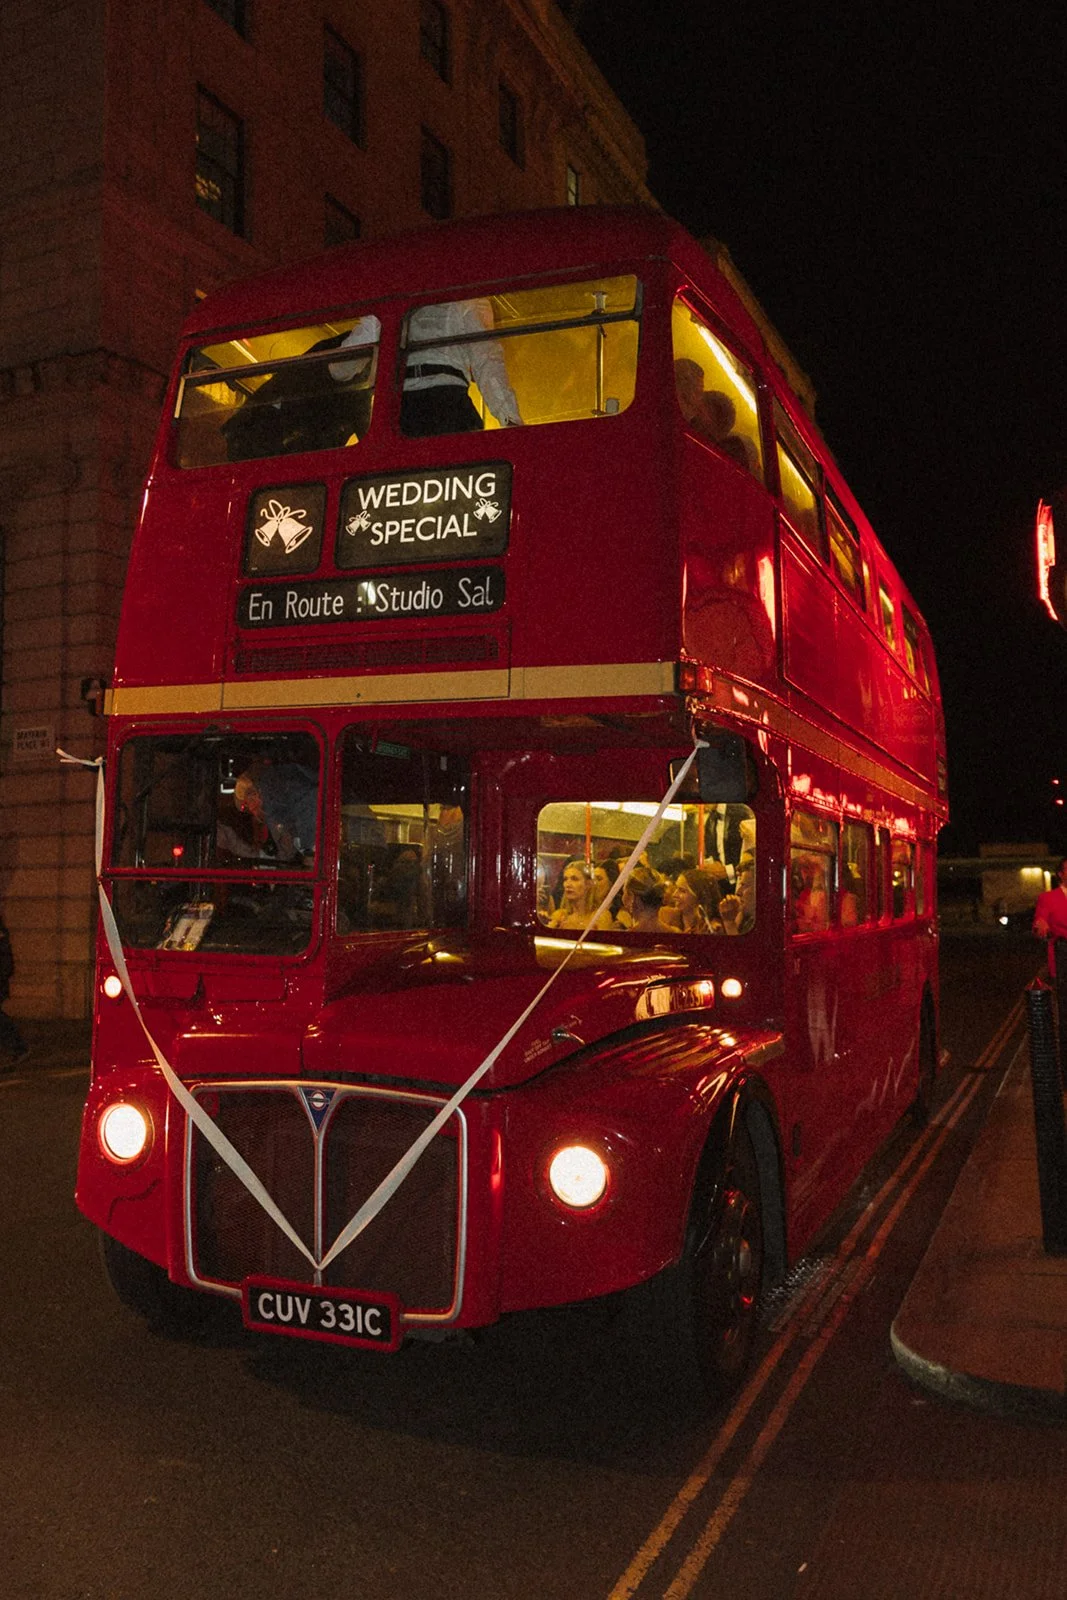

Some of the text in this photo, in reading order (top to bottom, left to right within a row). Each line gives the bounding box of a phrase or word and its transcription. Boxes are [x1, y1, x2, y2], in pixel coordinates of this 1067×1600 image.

[358, 473, 496, 510] WEDDING
[371, 513, 477, 546] SPECIAL
[248, 592, 273, 621] En
[286, 591, 344, 619] Route
[375, 581, 443, 613] Studio
[458, 577, 494, 607] Sal
[258, 1292, 382, 1336] CUV 331C
